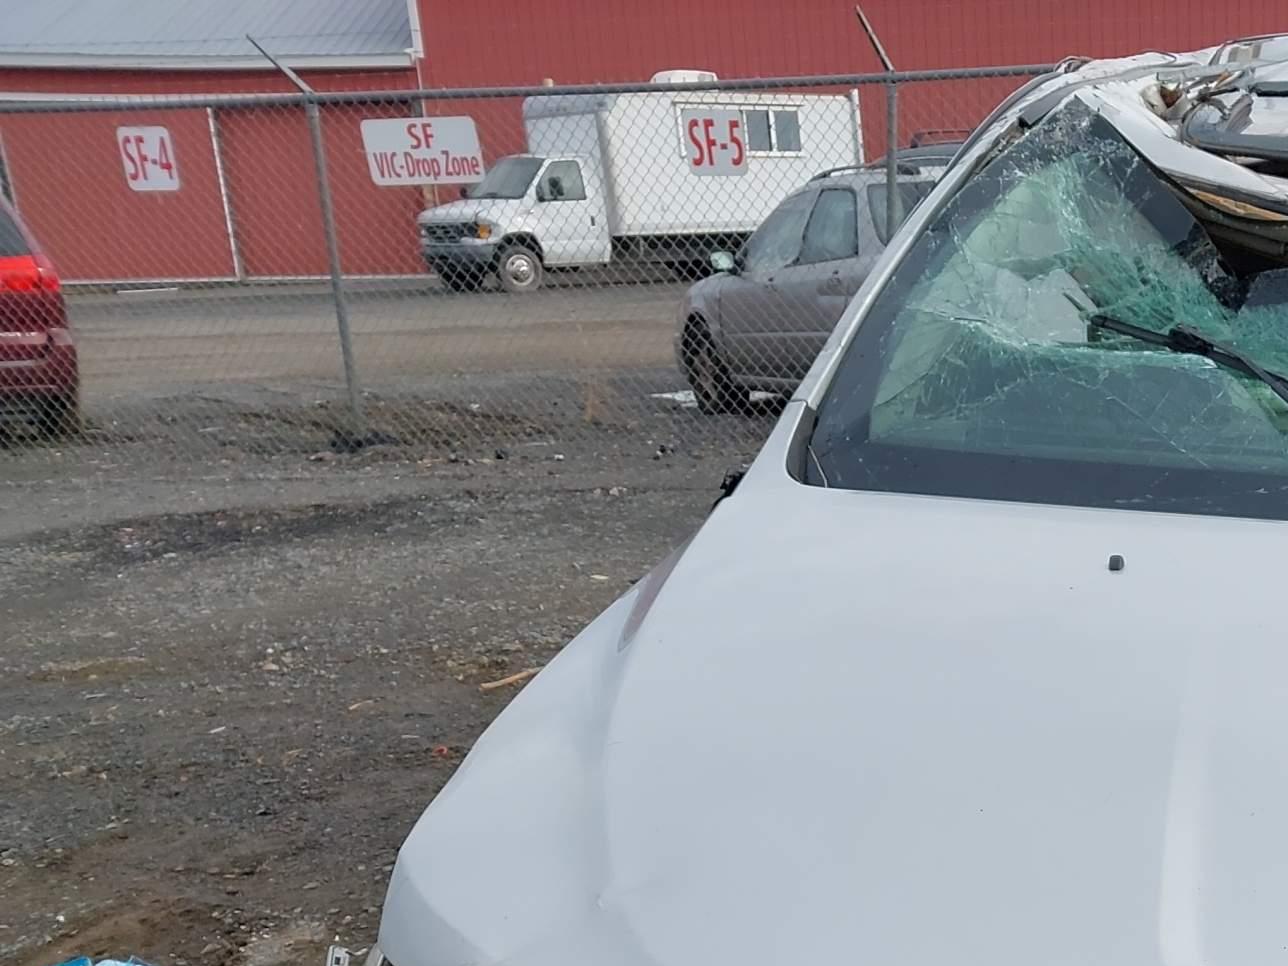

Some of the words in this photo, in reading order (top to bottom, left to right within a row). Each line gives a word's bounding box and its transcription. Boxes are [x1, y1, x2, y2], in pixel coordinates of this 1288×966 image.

[407, 123, 434, 149] SF
[688, 118, 743, 165] SF-5
[122, 135, 173, 180] SF-4
[372, 152, 441, 180] VIC-Drop
[440, 150, 480, 176] Zone
